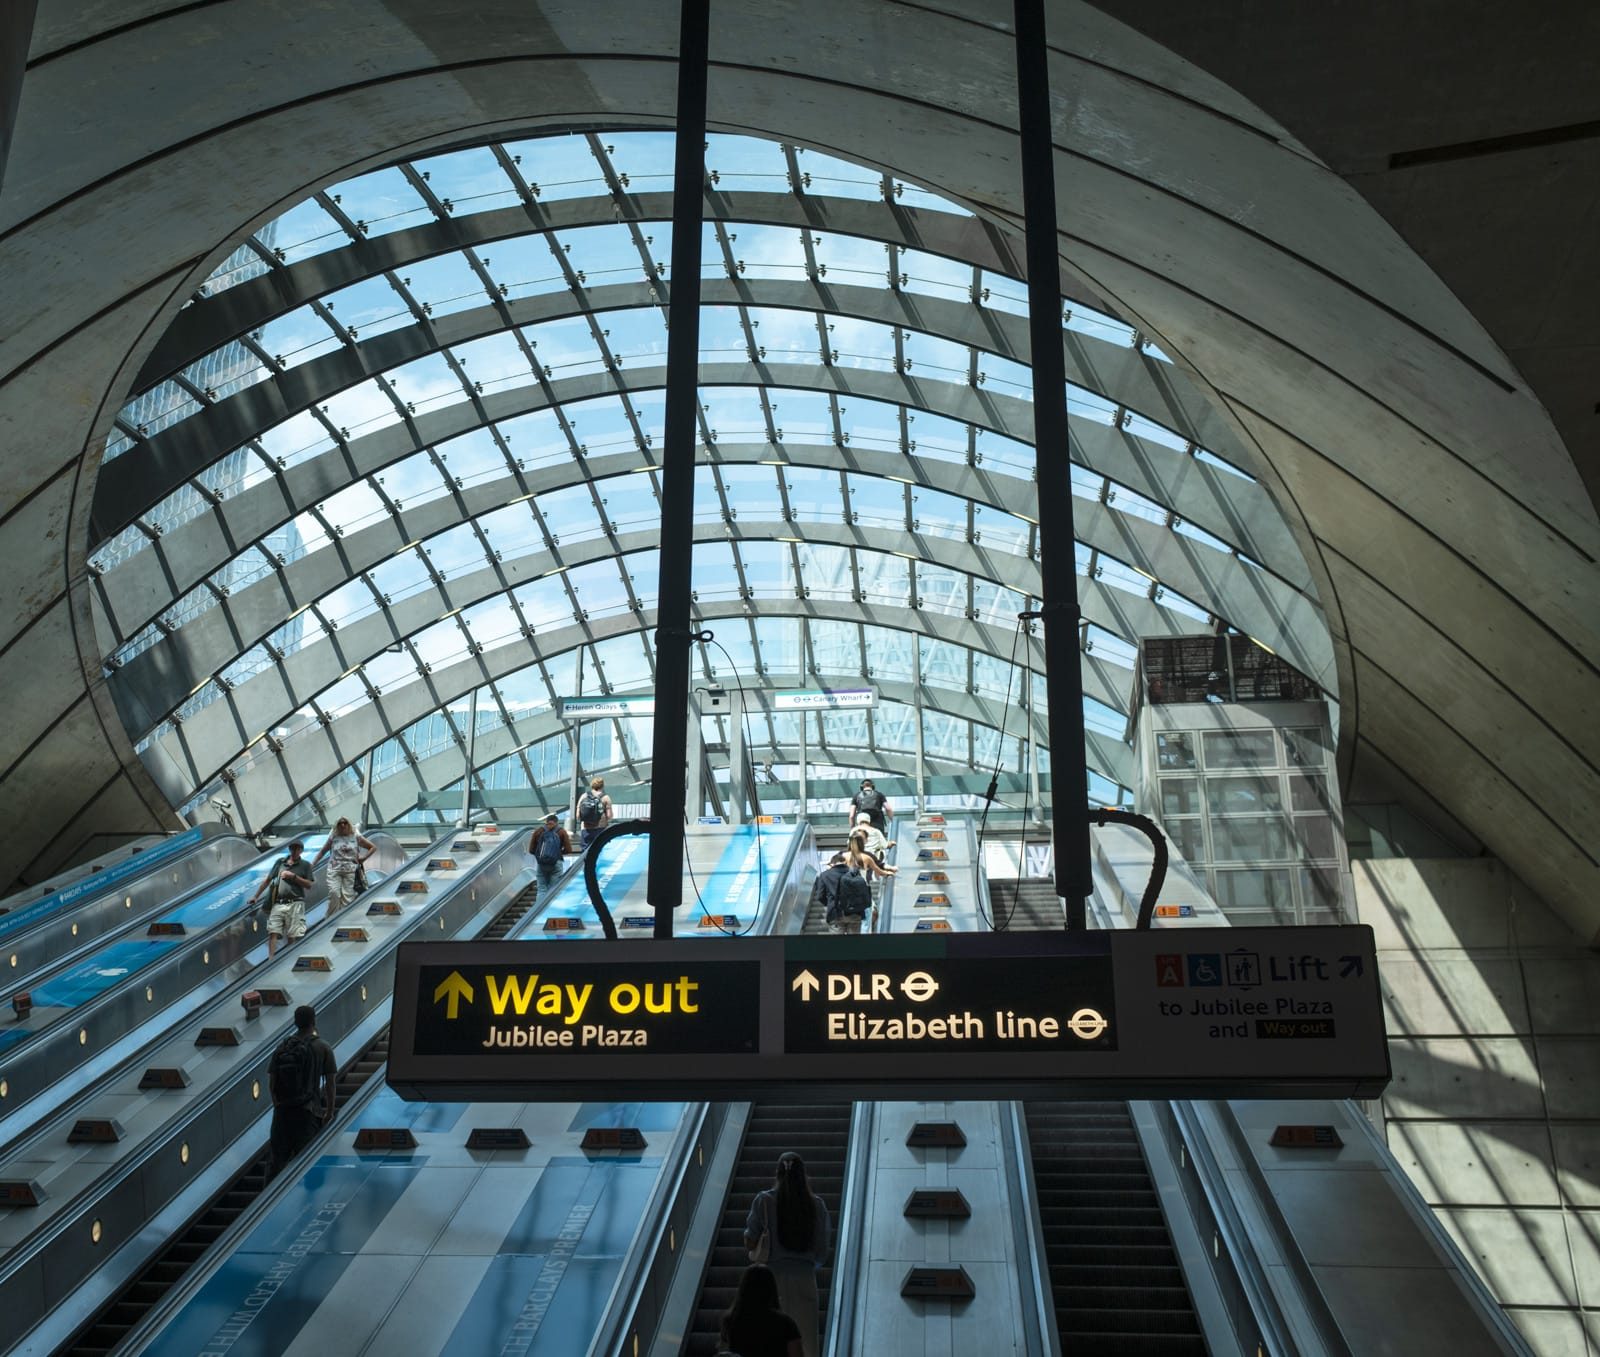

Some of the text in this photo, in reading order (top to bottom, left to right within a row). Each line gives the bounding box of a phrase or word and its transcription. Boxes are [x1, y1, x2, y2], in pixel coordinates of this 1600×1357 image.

[595, 703, 617, 711] Quays
[813, 694, 863, 703] Canary Wharf
[1161, 956, 1329, 984] A Lift
[485, 974, 699, 1025] Way out
[827, 974, 894, 1001] DLR
[1159, 998, 1333, 1016] to Jubilee Plaza
[482, 1024, 648, 1047] Jubilee Plaza
[827, 1010, 1059, 1040] Elizabeth line
[1209, 1021, 1328, 1038] and Way out
[317, 1202, 347, 1218] BE
[288, 1229, 325, 1258] STEP
[513, 1260, 569, 1330] BARCLAYS
[553, 1204, 594, 1256] PREMIER
[243, 1260, 297, 1308] AHEAD
[208, 1309, 259, 1347] WITH
